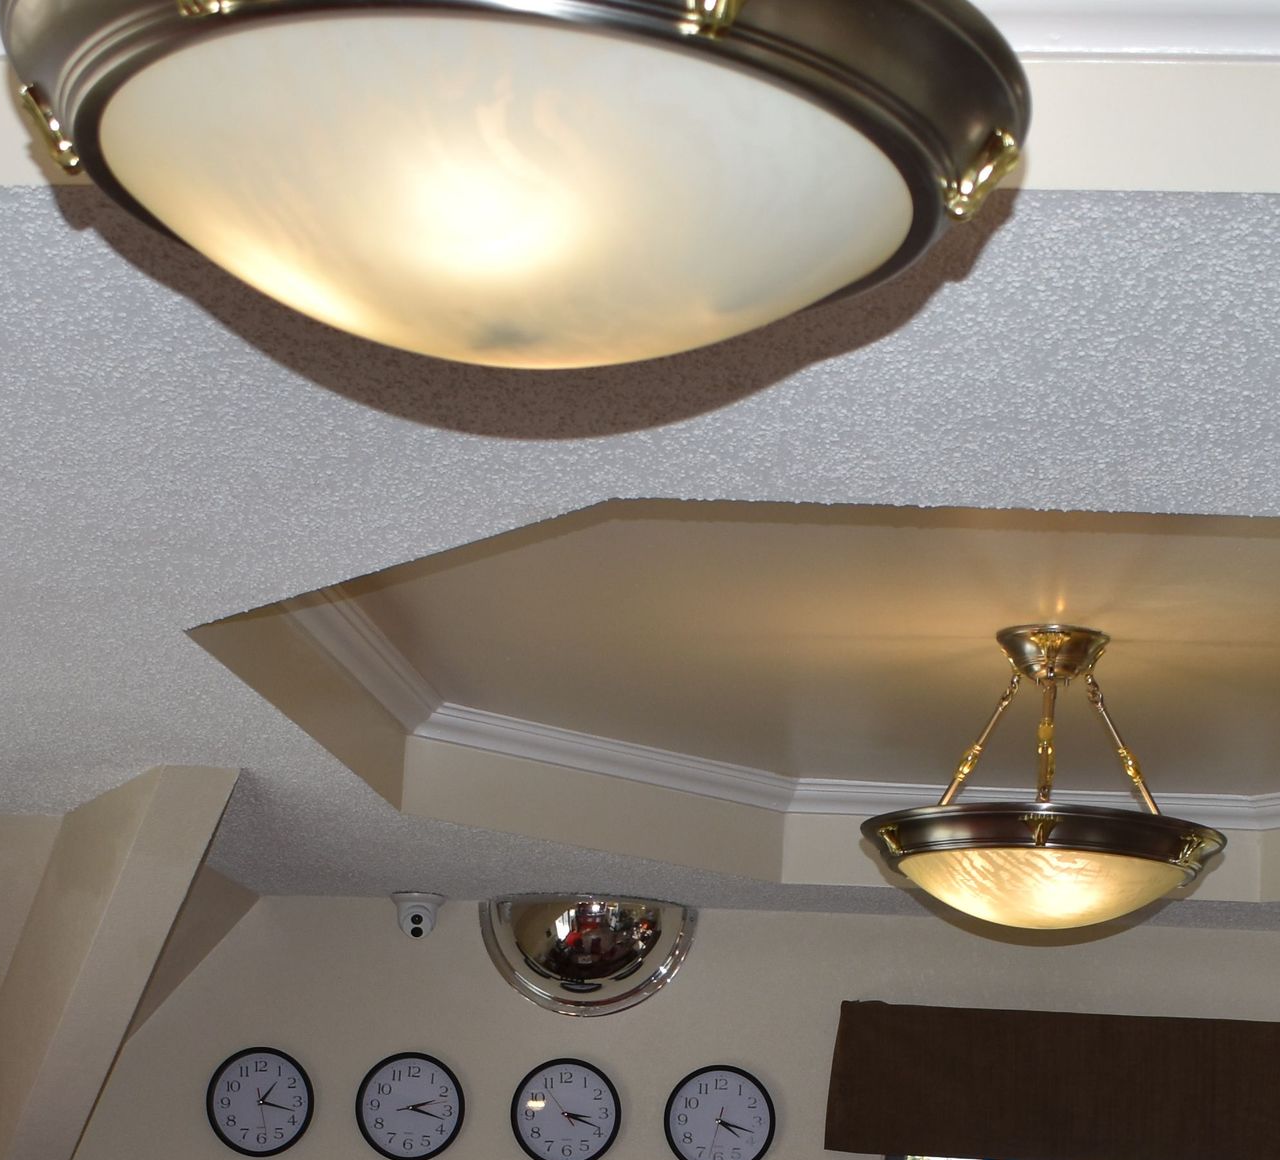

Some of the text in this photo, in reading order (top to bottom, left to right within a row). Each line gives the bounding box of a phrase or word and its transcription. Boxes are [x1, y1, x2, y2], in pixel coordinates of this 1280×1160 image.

[239, 1066, 249, 1077] 11
[254, 1060, 268, 1072] 12
[277, 1066, 282, 1076] 1
[408, 1066, 421, 1078] 12
[392, 1069, 402, 1081] 11
[430, 1073, 435, 1084] 1
[559, 1072, 573, 1084] 12
[226, 1081, 241, 1092] 10
[287, 1077, 297, 1089] 2
[544, 1077, 555, 1089] 11
[583, 1077, 588, 1088] 1
[714, 1078, 728, 1090] 12
[377, 1083, 392, 1095] 10
[439, 1085, 449, 1097] 2
[593, 1088, 603, 1101] 2
[698, 1083, 709, 1095] 11
[737, 1084, 743, 1095] 1
[220, 1097, 231, 1108] 9
[293, 1095, 303, 1108] 3
[530, 1092, 546, 1102] 10
[684, 1097, 699, 1109] 10
[747, 1097, 757, 1109] 2
[370, 1099, 380, 1111] 9
[443, 1105, 453, 1117] 3
[524, 1109, 535, 1121] 9
[598, 1107, 609, 1120] 3
[226, 1115, 236, 1126] 8
[287, 1115, 298, 1126] 4
[374, 1117, 384, 1129] 8
[677, 1114, 688, 1126] 9
[752, 1116, 763, 1128] 3
[240, 1128, 250, 1140] 7
[273, 1127, 284, 1139] 5
[435, 1123, 446, 1135] 4
[530, 1127, 541, 1138] 8
[593, 1127, 604, 1138] 4
[256, 1132, 267, 1145] 6
[386, 1133, 397, 1144] 7
[420, 1135, 431, 1147] 5
[682, 1132, 693, 1144] 8
[402, 1138, 413, 1151] 6
[544, 1140, 555, 1152] 7
[579, 1140, 590, 1151] 5
[561, 1145, 572, 1157] 6
[696, 1146, 706, 1158] 7
[730, 1148, 741, 1160] 5
